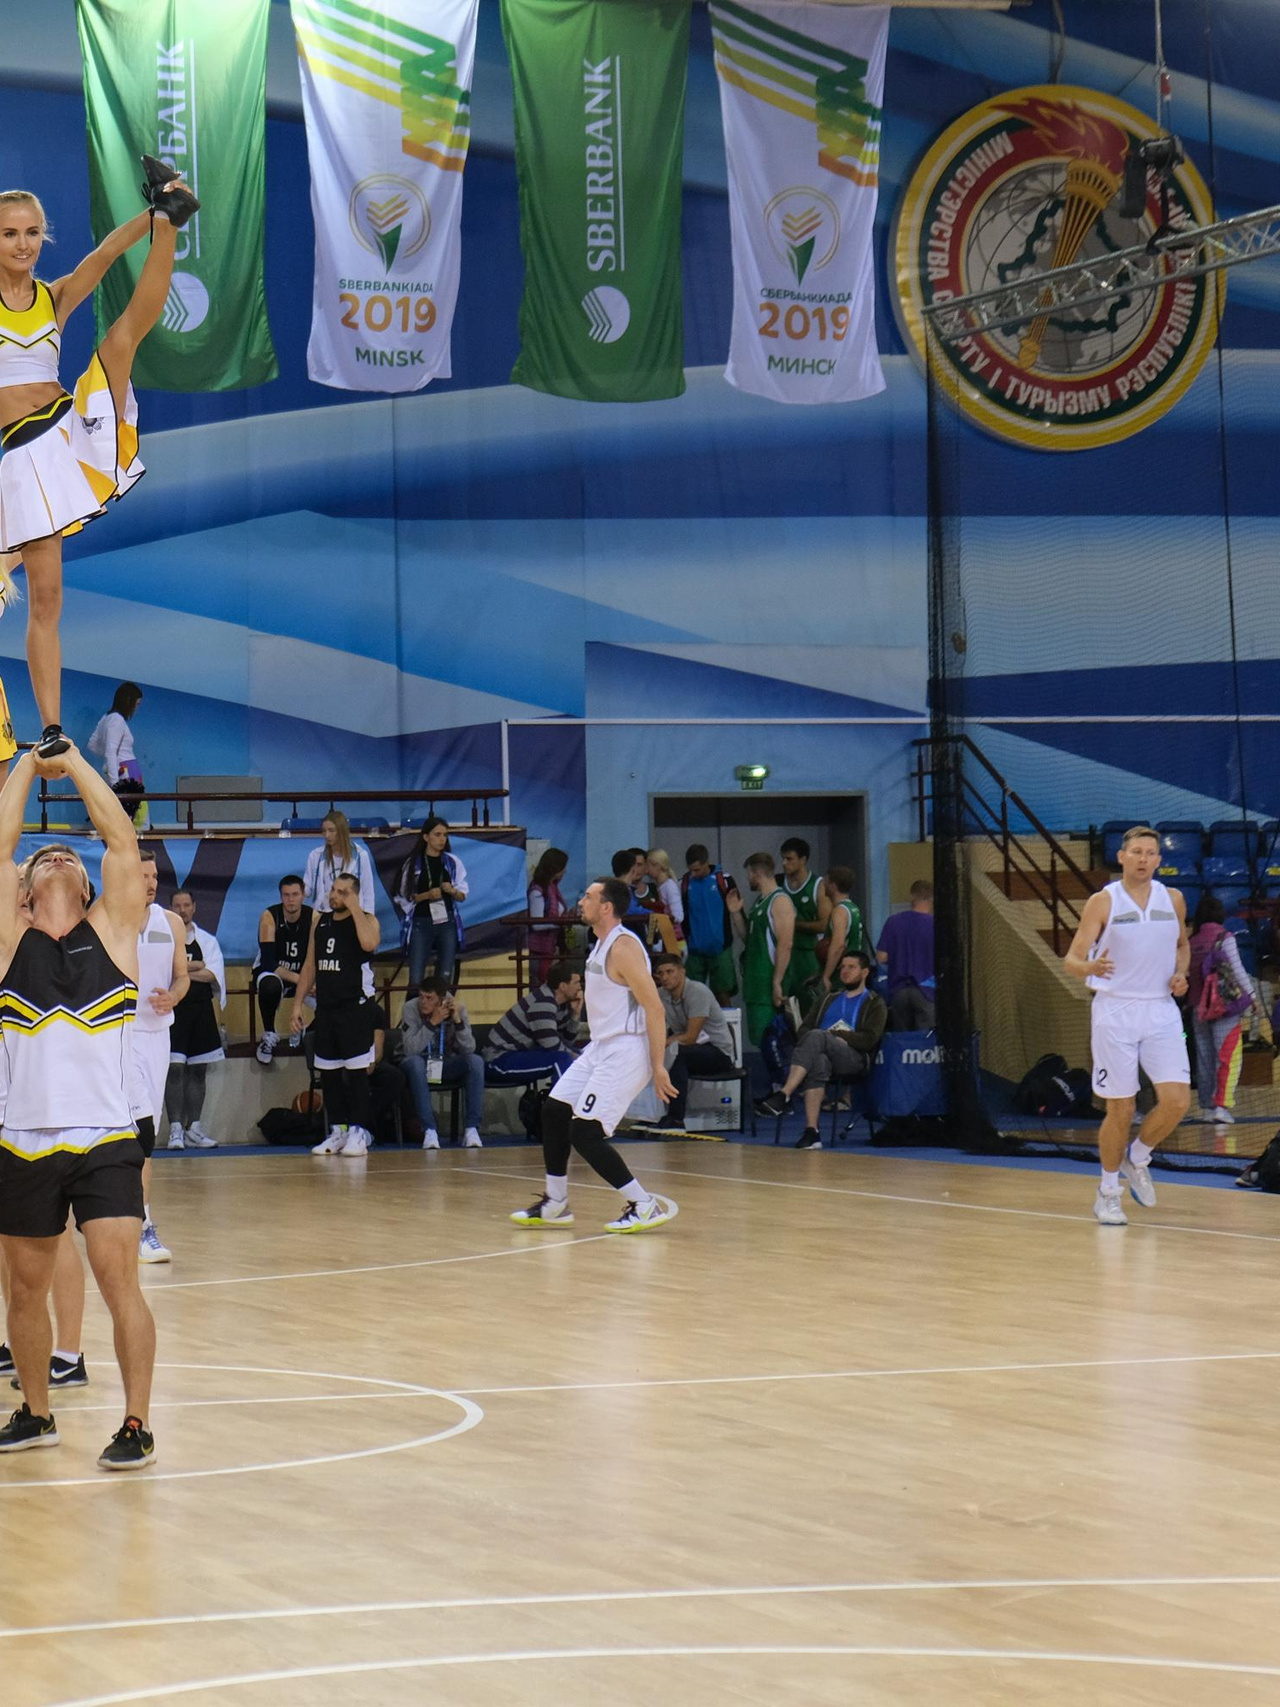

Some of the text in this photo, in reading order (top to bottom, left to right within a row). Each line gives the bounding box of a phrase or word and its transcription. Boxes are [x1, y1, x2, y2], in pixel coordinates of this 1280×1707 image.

[583, 56, 617, 272] SBERBANK
[338, 278, 434, 293] SBERBANKIADA
[760, 287, 852, 304] СБЕРБАНКИАДА
[339, 293, 437, 333] 2019
[758, 302, 851, 341] 2019
[355, 346, 426, 367] MINSK
[767, 355, 837, 375] МИНСК
[285, 941, 298, 957] 15
[326, 937, 336, 954] 9
[582, 1093, 597, 1113] 9
